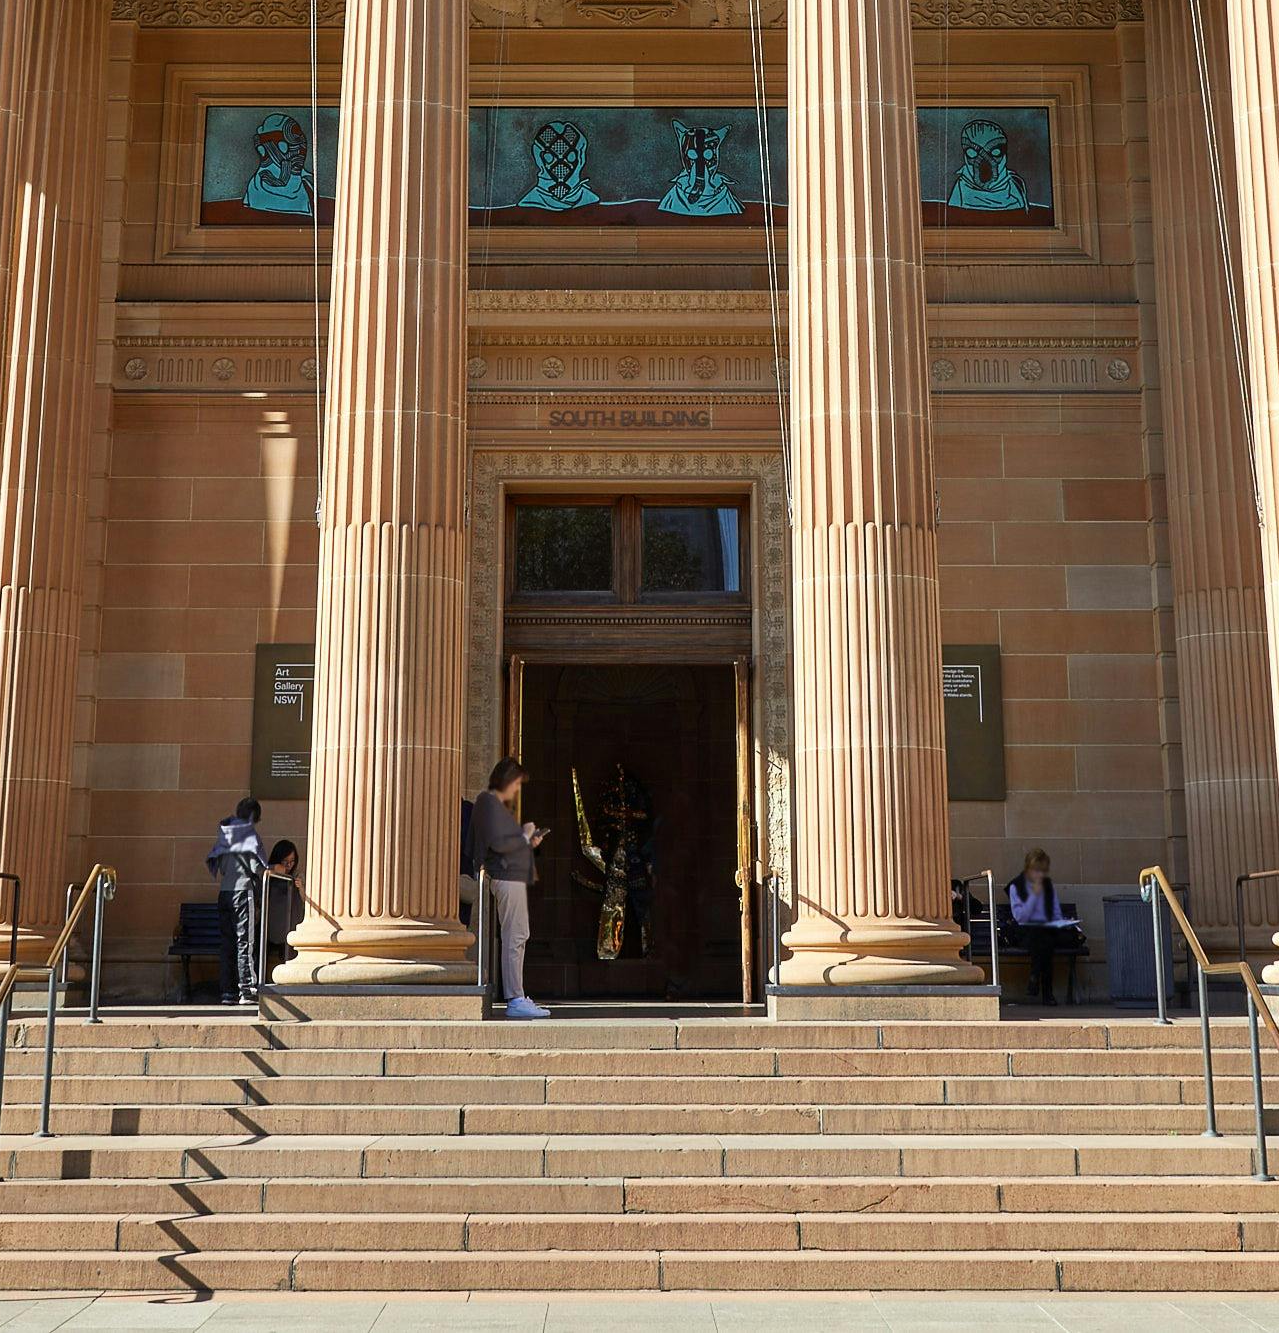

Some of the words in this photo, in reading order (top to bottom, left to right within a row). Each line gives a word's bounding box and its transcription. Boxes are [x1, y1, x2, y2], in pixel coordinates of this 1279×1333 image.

[549, 410, 616, 427] SOUTH
[620, 410, 710, 427] BUILDING
[275, 668, 290, 676] Art
[274, 681, 304, 691] Gallery
[274, 696, 297, 704] NSW
